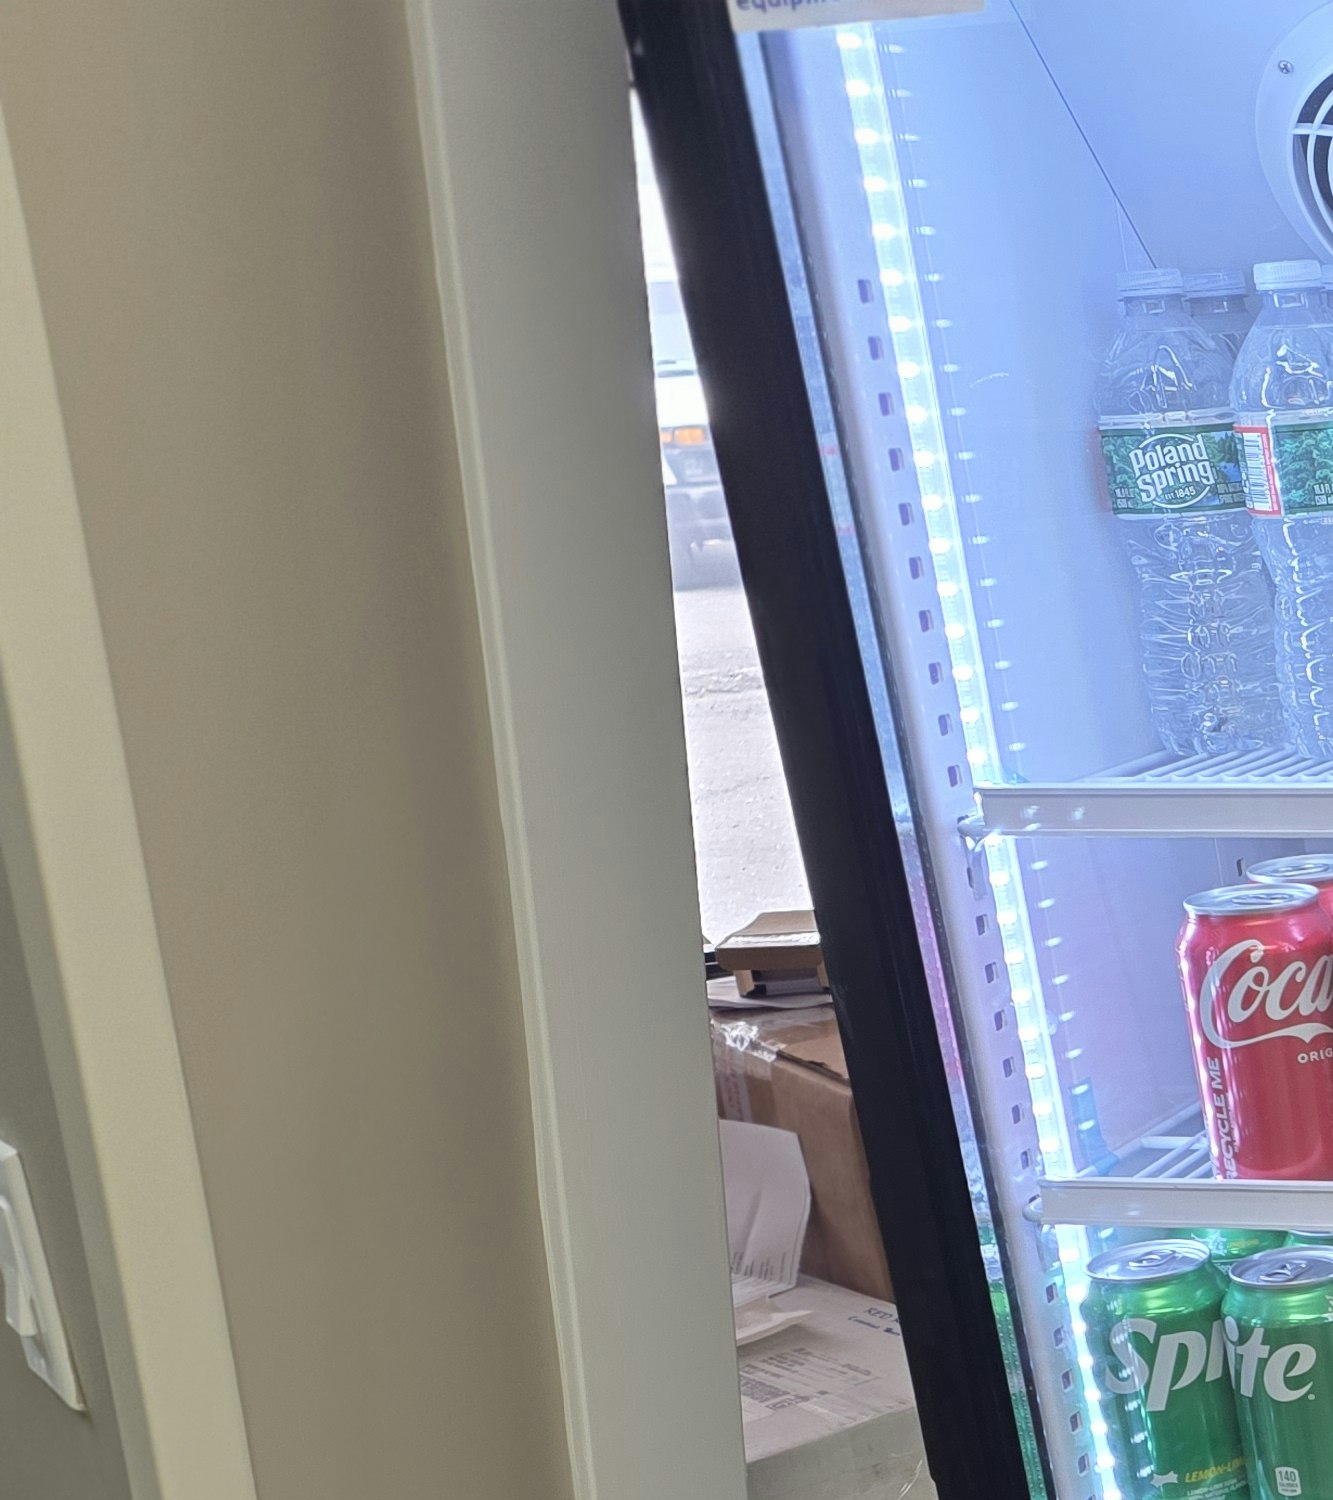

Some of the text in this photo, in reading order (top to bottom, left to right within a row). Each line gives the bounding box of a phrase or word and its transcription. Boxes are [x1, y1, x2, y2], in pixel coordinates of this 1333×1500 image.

[1129, 434, 1208, 476] Poland
[1136, 461, 1215, 502] Spring
[1278, 1471, 1296, 1483] 140
